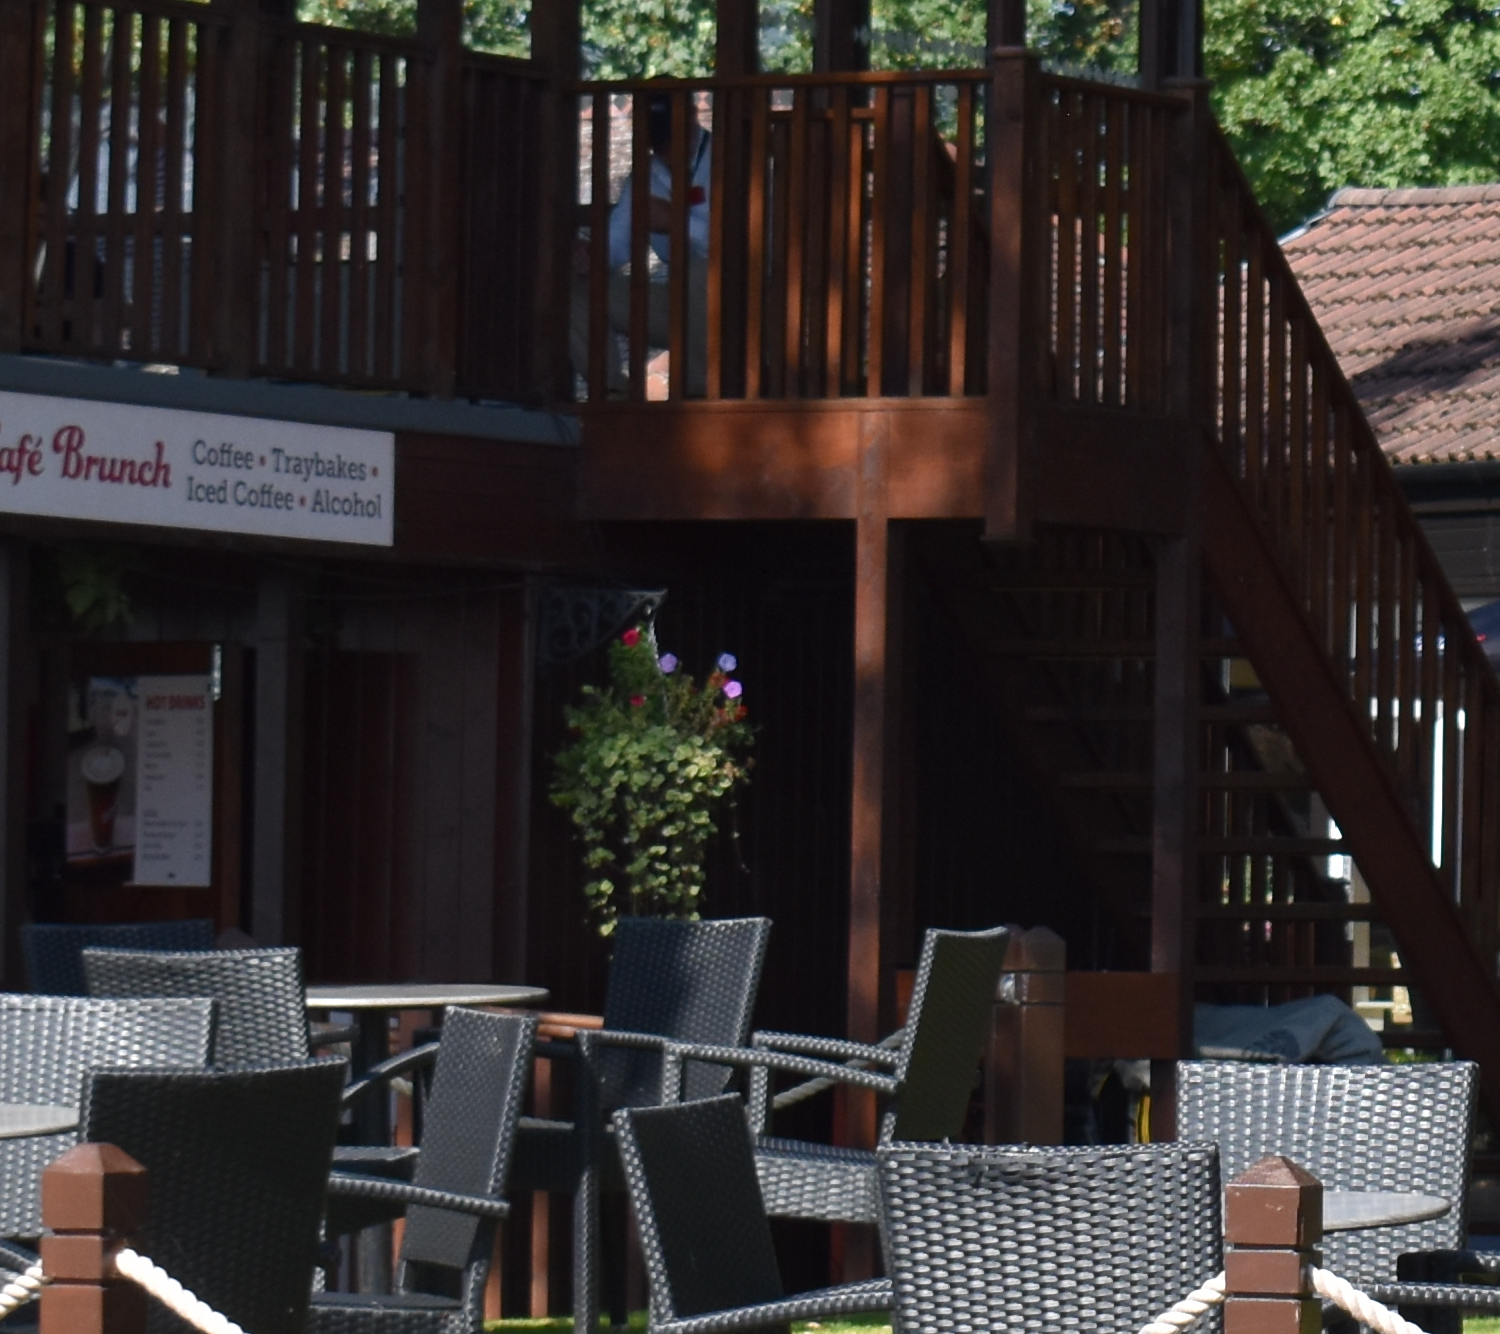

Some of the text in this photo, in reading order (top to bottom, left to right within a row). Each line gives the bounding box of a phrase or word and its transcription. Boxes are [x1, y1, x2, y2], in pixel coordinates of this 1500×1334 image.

[52, 424, 172, 489] Brunch
[192, 439, 368, 481] Coffee Traybakes
[186, 476, 382, 520] Iced Coffee Alcohol
[145, 694, 205, 709] HOT DRINKS
